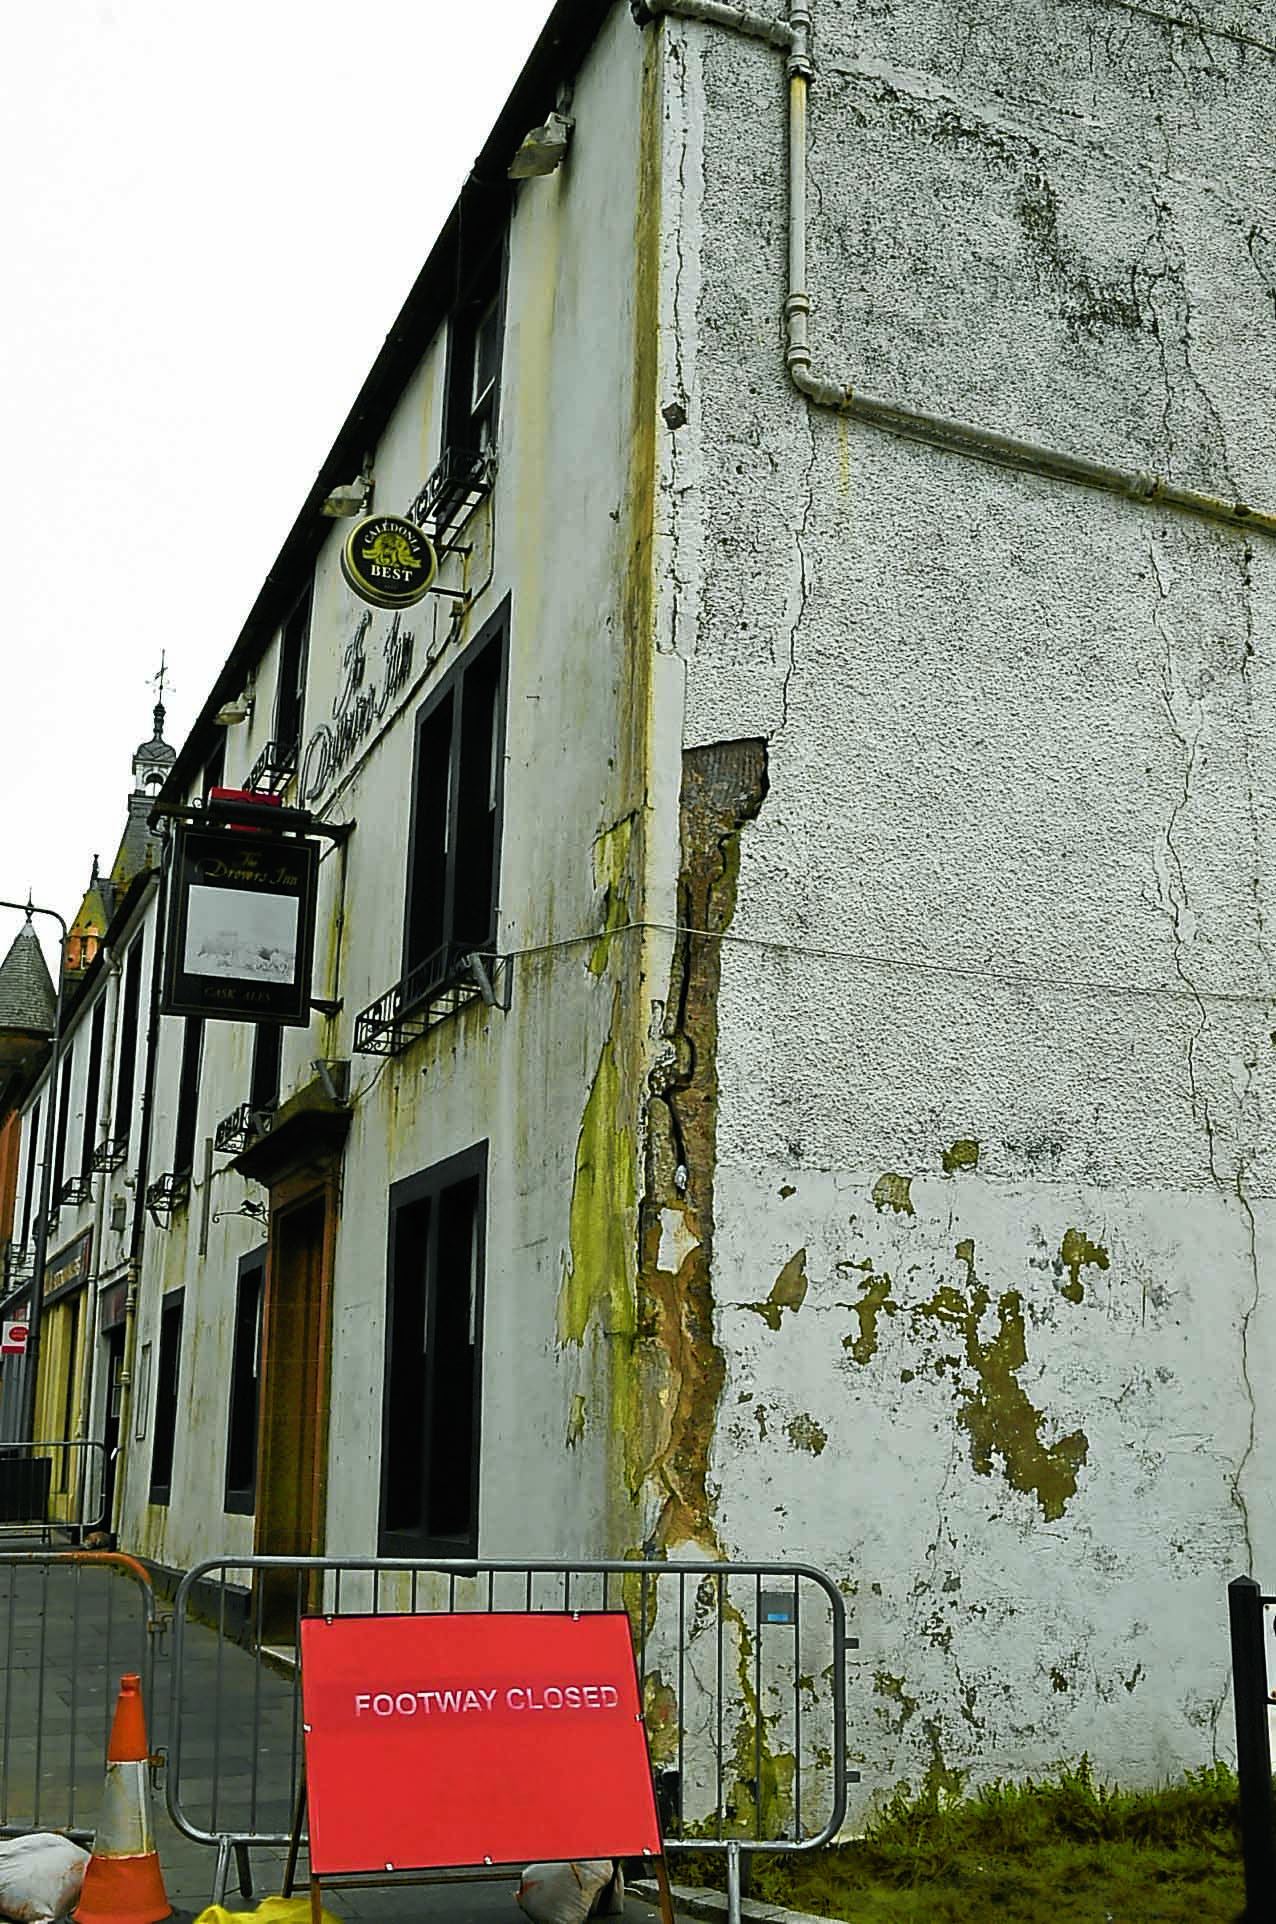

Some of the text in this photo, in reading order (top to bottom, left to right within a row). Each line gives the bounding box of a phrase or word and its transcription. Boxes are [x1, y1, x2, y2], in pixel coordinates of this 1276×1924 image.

[364, 521, 421, 553] CALEDONIA
[370, 564, 413, 582] BEST
[354, 1686, 619, 1717] FOOTWAY CLOSED
